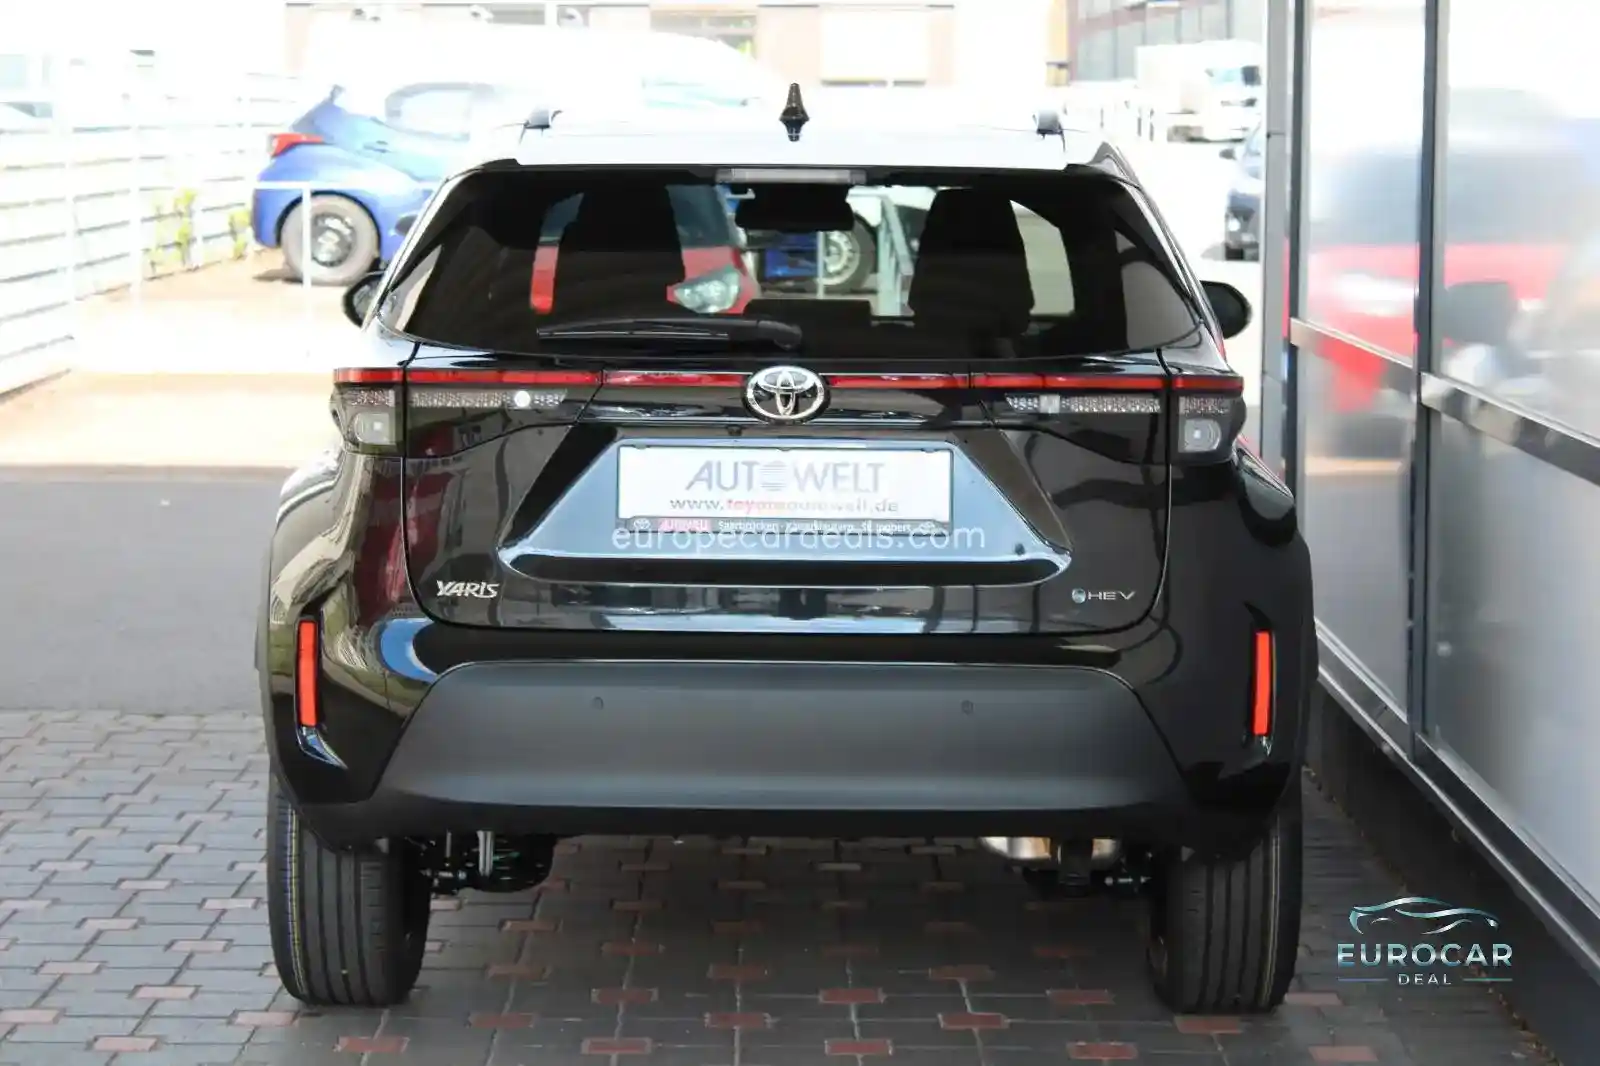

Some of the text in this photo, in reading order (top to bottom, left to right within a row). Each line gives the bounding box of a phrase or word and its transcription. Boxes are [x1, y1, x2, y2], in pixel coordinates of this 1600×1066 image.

[685, 460, 885, 491] AUTOWELT
[436, 580, 500, 598] YARIS
[1088, 590, 1136, 600] HEV
